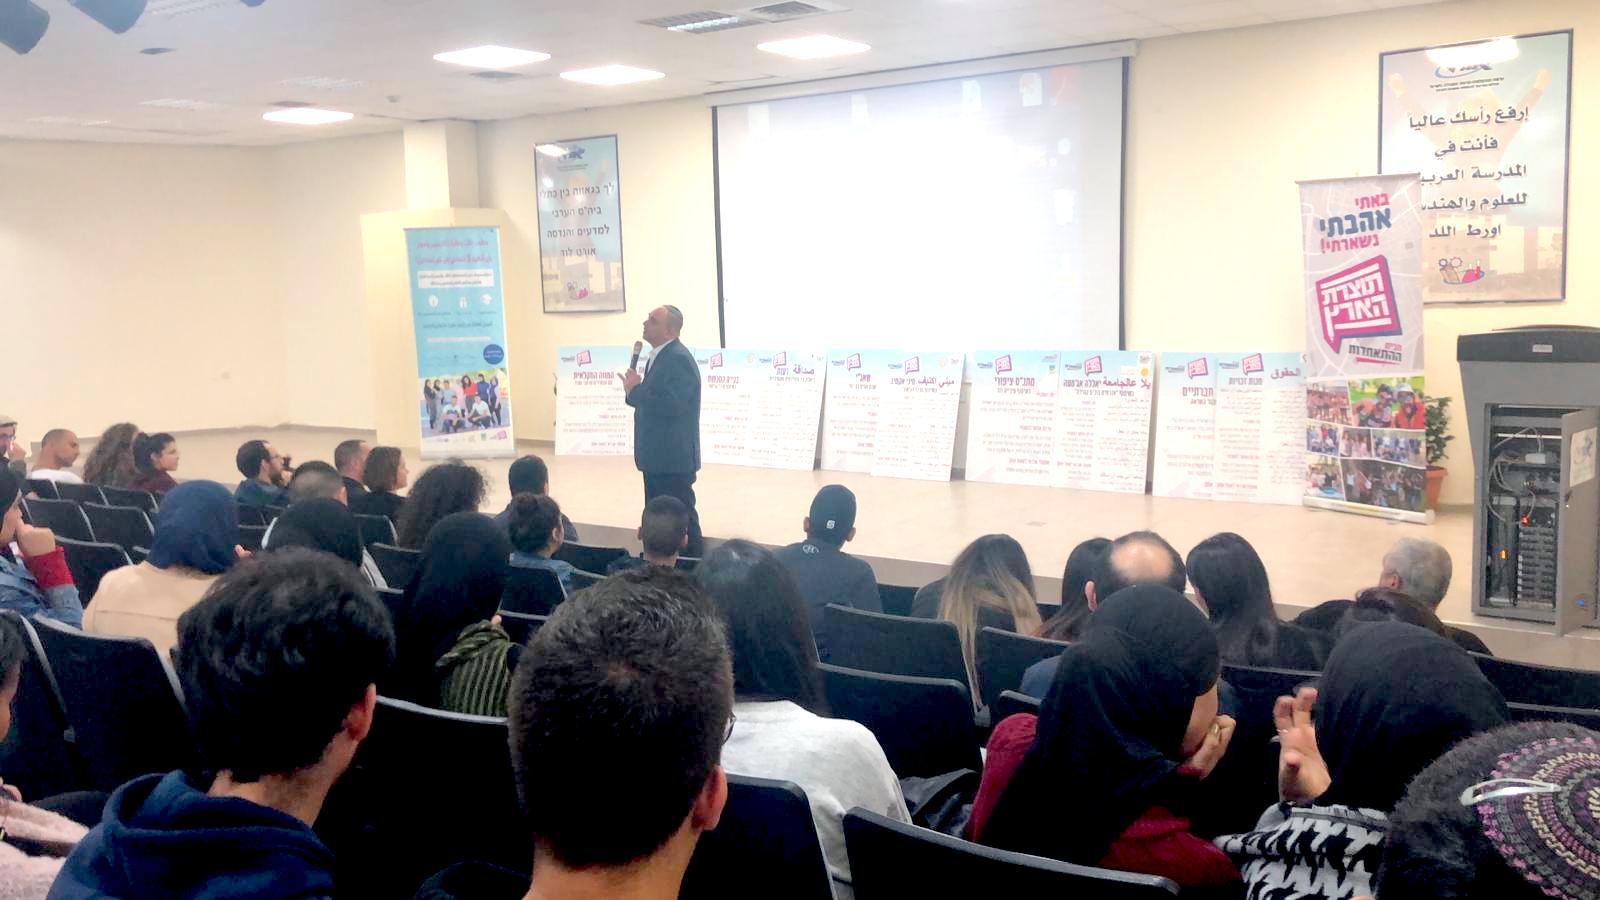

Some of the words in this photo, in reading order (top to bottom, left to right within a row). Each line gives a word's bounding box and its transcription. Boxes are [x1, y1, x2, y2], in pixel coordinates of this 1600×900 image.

[1450, 107, 1491, 125] رأسك
[1434, 141, 1456, 161] في
[1460, 134, 1498, 152] فأنت
[1420, 169, 1464, 186] العربي
[1471, 164, 1527, 180] المدرسة
[559, 188, 570, 200] בין
[1355, 193, 1390, 210] באתי
[1480, 193, 1528, 210] للعلوم
[576, 224, 610, 237] למדעים
[1319, 207, 1392, 238] אהבתי
[1320, 234, 1380, 254] נשארתי!
[1320, 271, 1386, 307] תוצרת
[1323, 294, 1391, 343] הארץ
[1348, 344, 1403, 362] ההתאחדות
